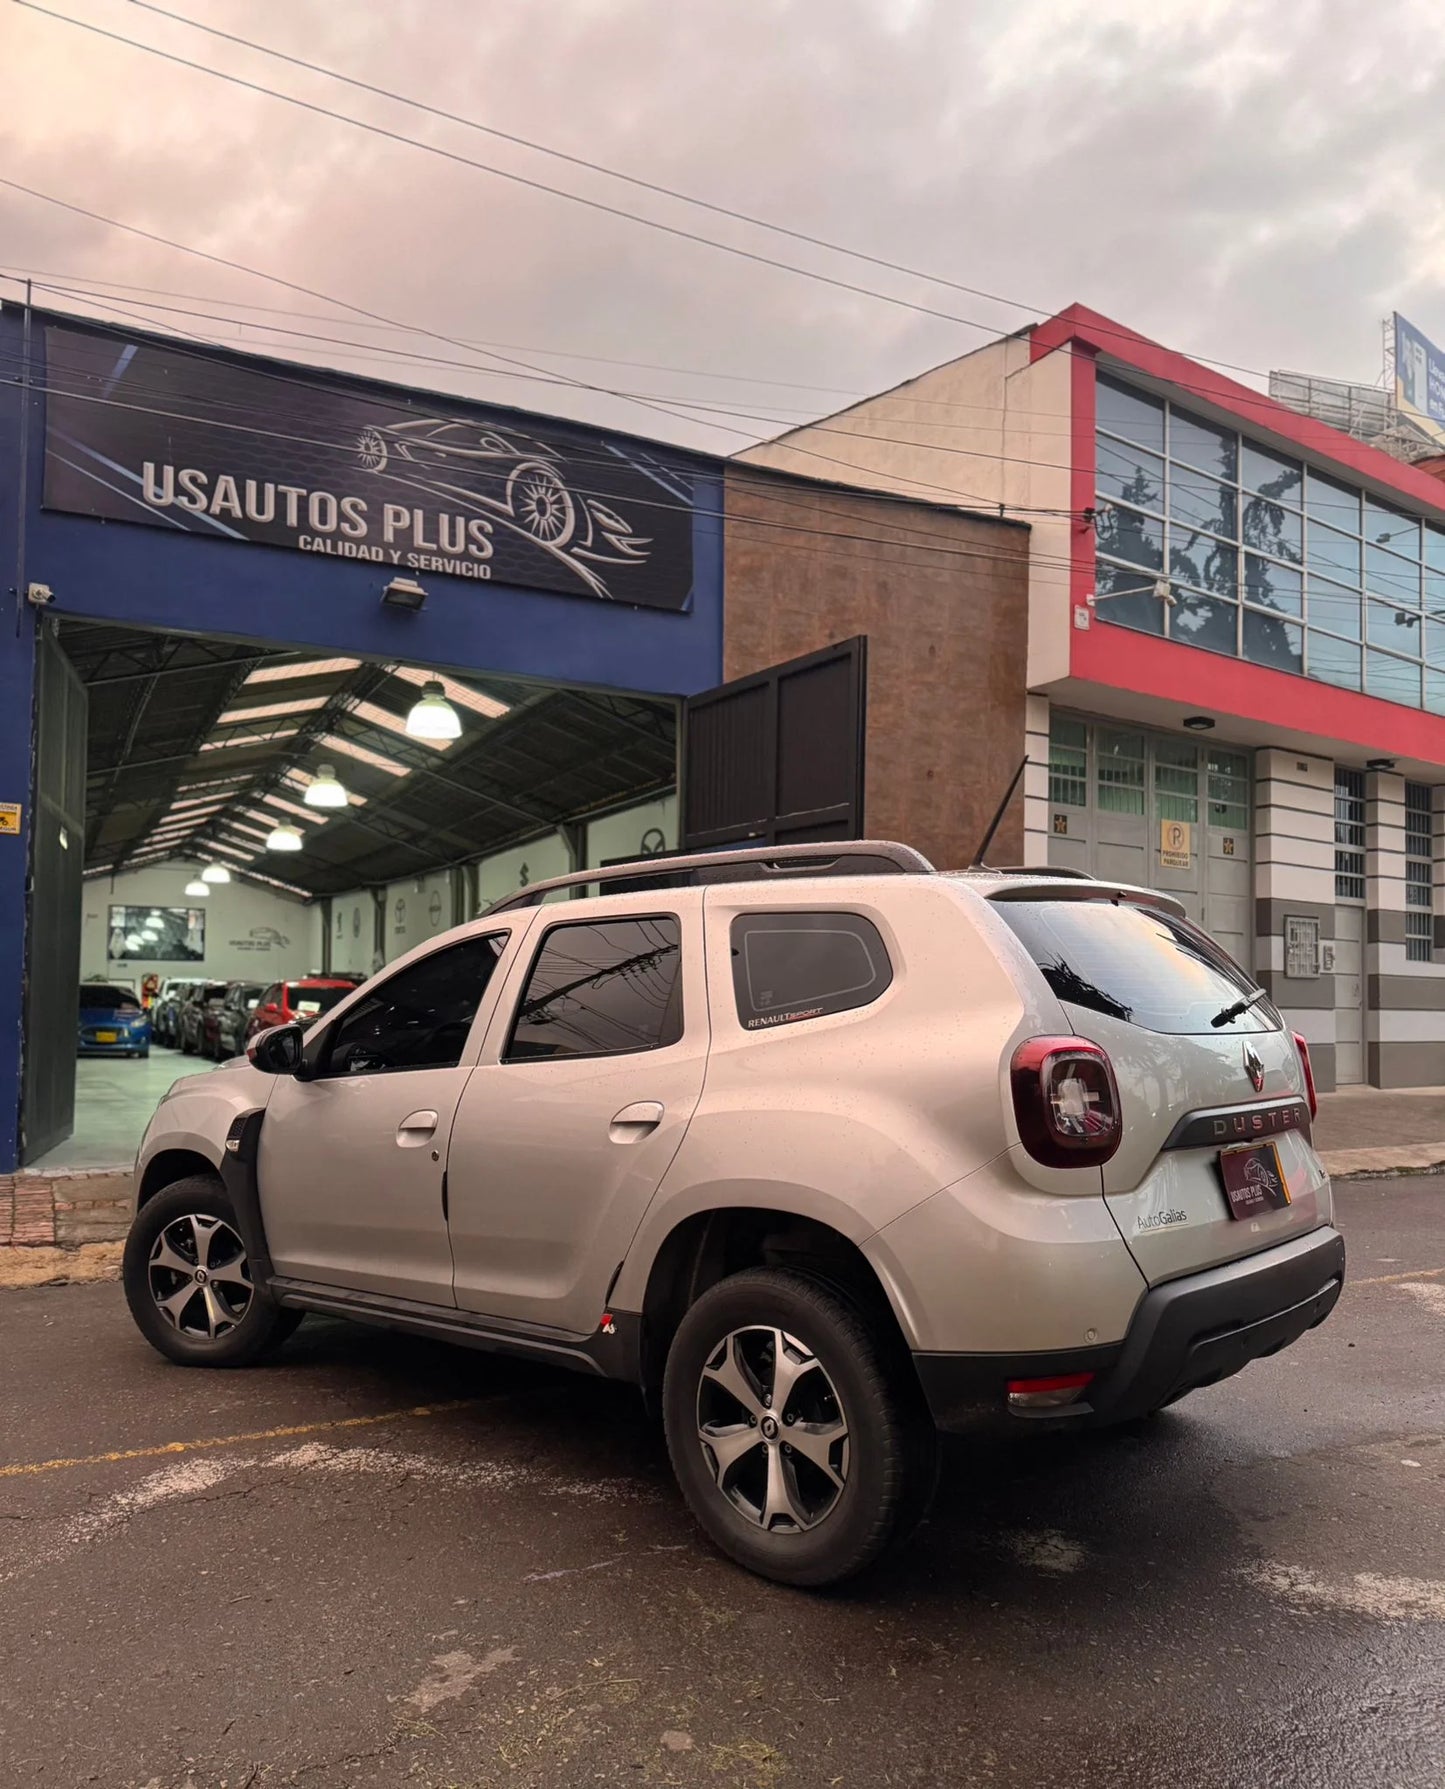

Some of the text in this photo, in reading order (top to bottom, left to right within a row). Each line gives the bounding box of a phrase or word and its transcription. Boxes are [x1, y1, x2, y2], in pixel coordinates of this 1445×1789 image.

[142, 461, 495, 560] USAUTOS PLUS
[298, 535, 492, 580] CALIDAD Y SERVICIO
[1213, 1108, 1300, 1135] DUSTER
[1250, 1184, 1263, 1198] PLUS
[1137, 1208, 1188, 1229] AutoGalias
